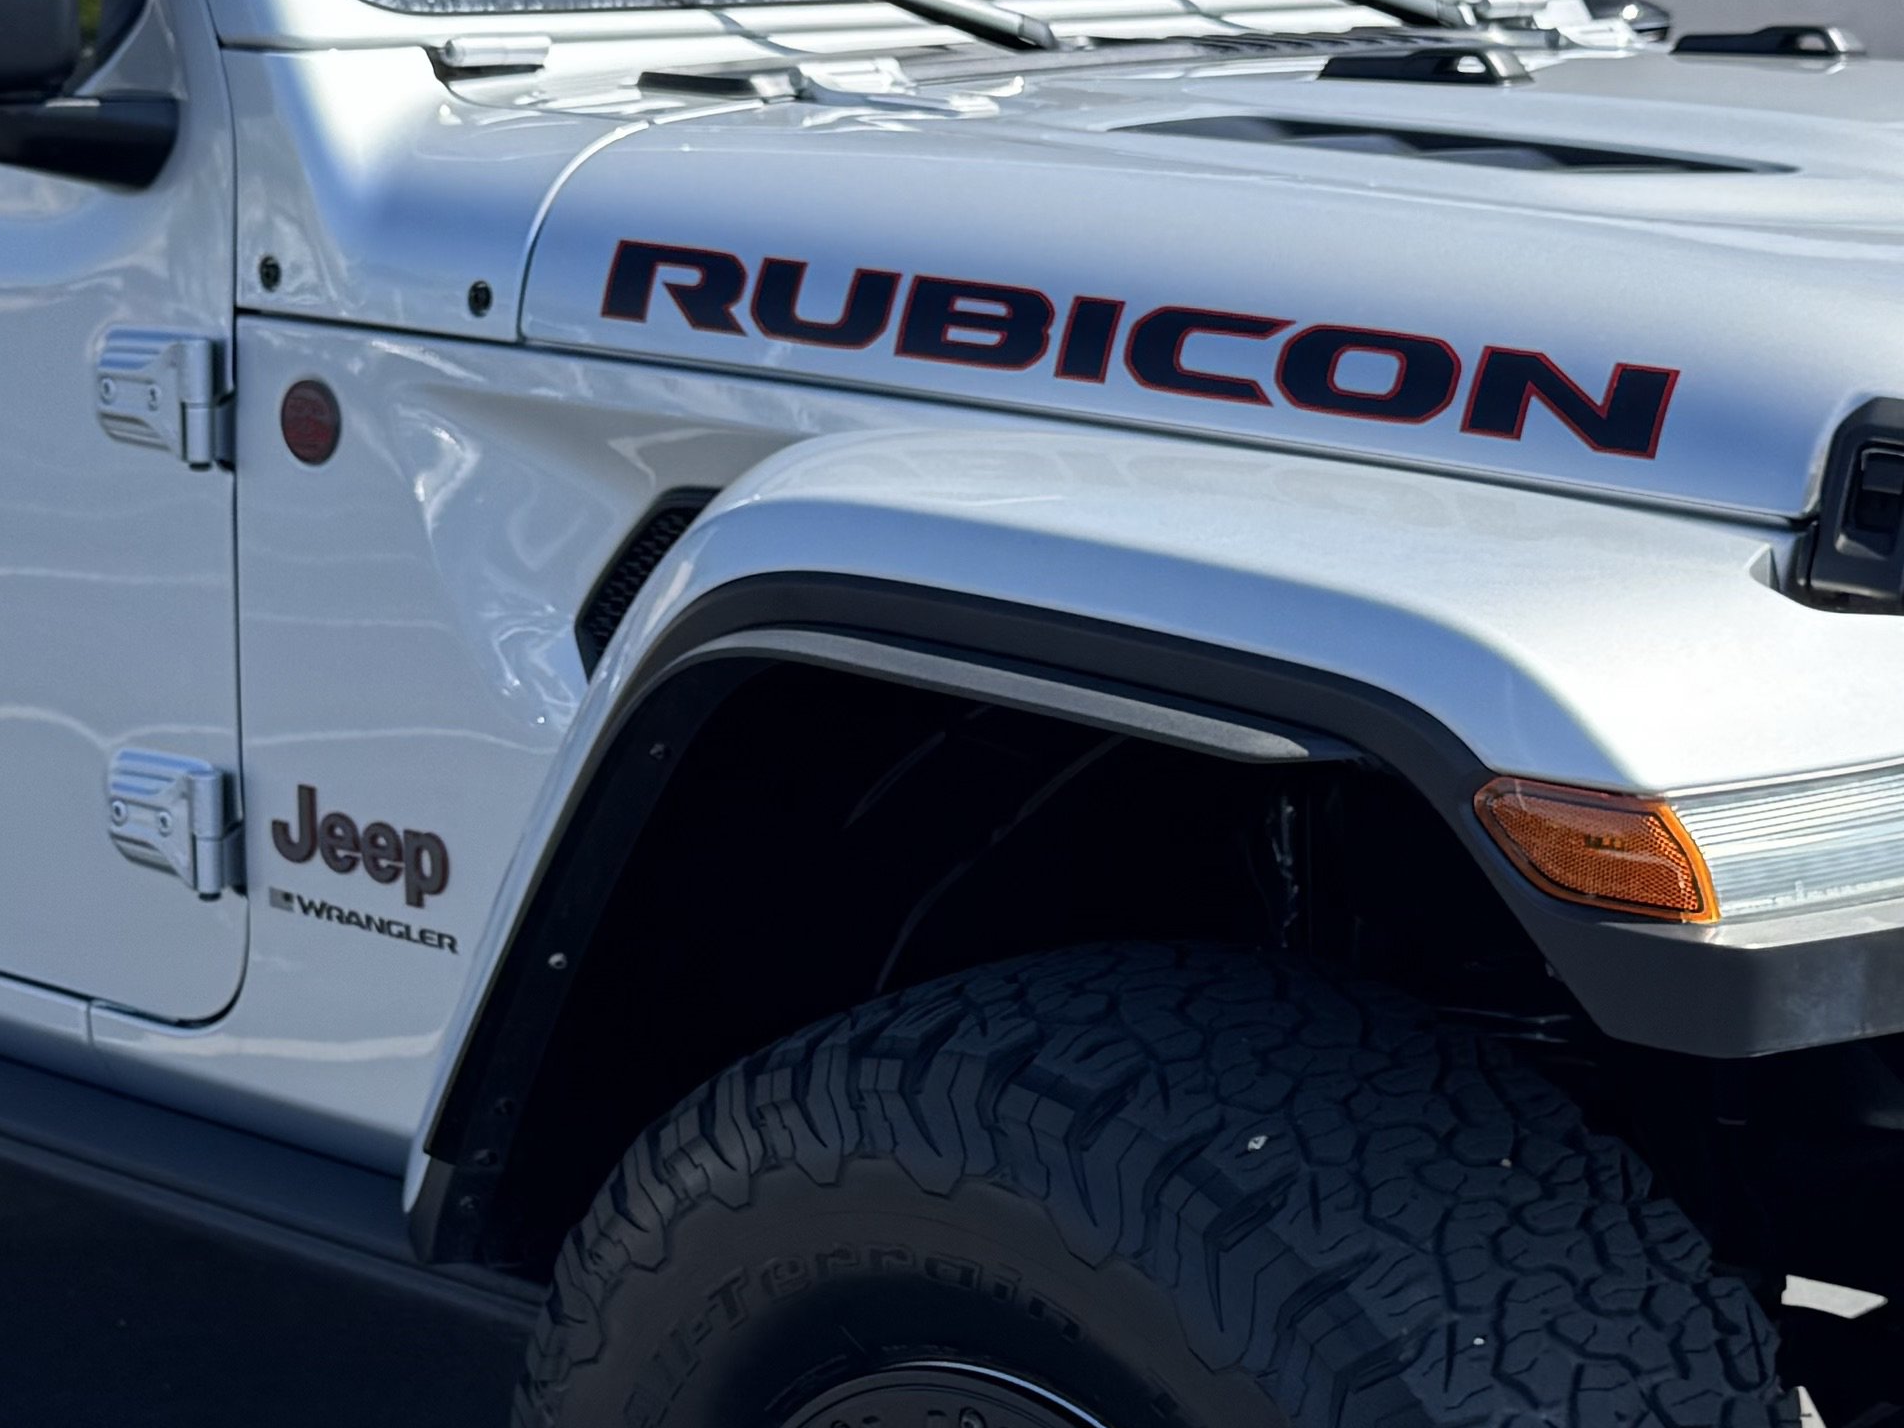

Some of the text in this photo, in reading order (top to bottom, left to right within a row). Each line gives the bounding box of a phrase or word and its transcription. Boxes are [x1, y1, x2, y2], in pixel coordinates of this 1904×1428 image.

[601, 239, 1682, 461] RUBICON
[271, 784, 450, 909] Jeep
[297, 893, 460, 955] WRANGLER
